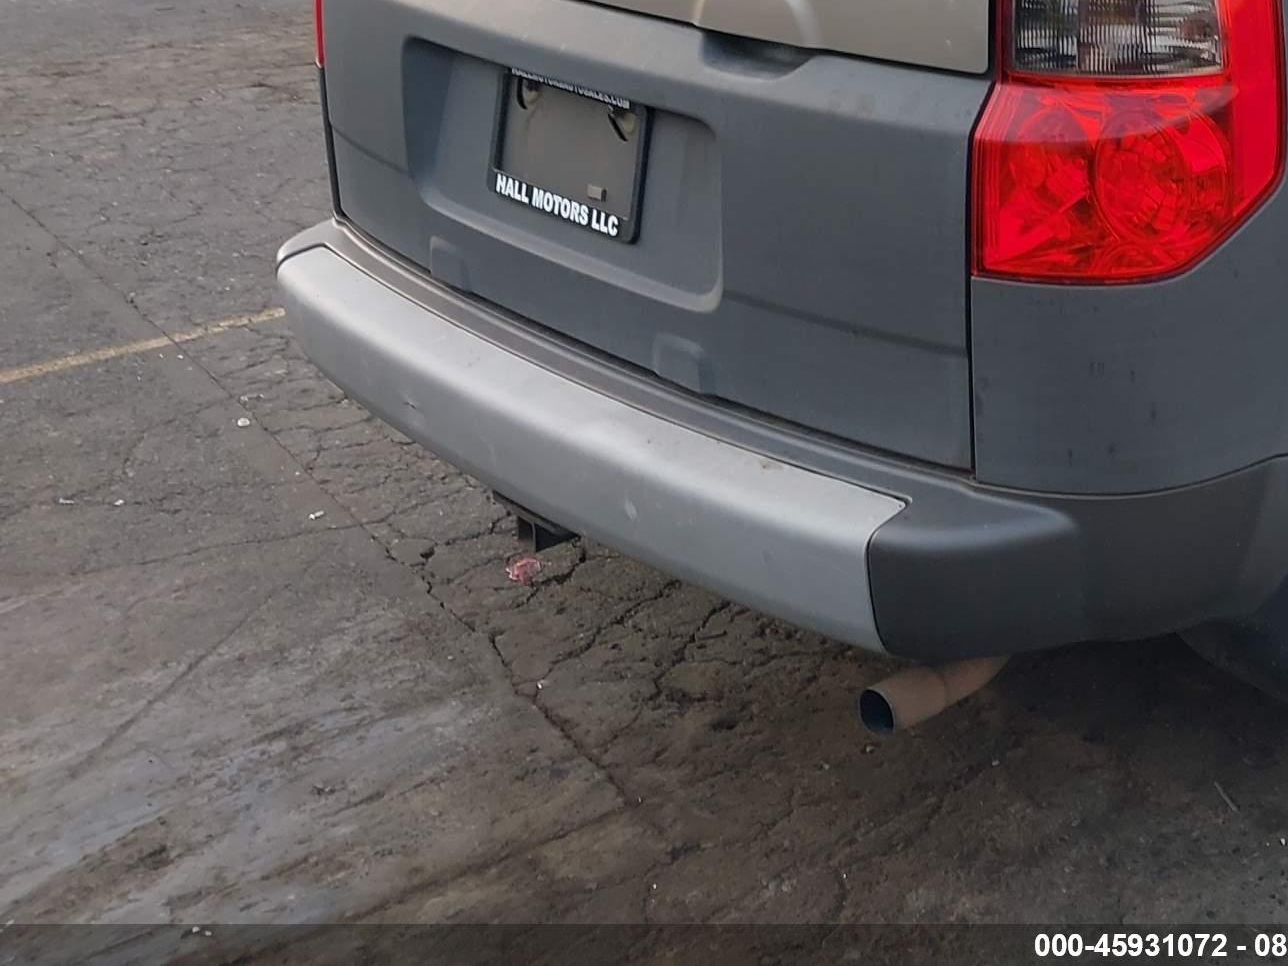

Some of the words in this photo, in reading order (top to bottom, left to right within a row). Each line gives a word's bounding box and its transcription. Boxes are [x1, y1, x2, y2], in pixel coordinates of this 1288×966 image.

[495, 173, 530, 205] HALL
[532, 186, 589, 226] MOTORS
[591, 208, 619, 237] LLC
